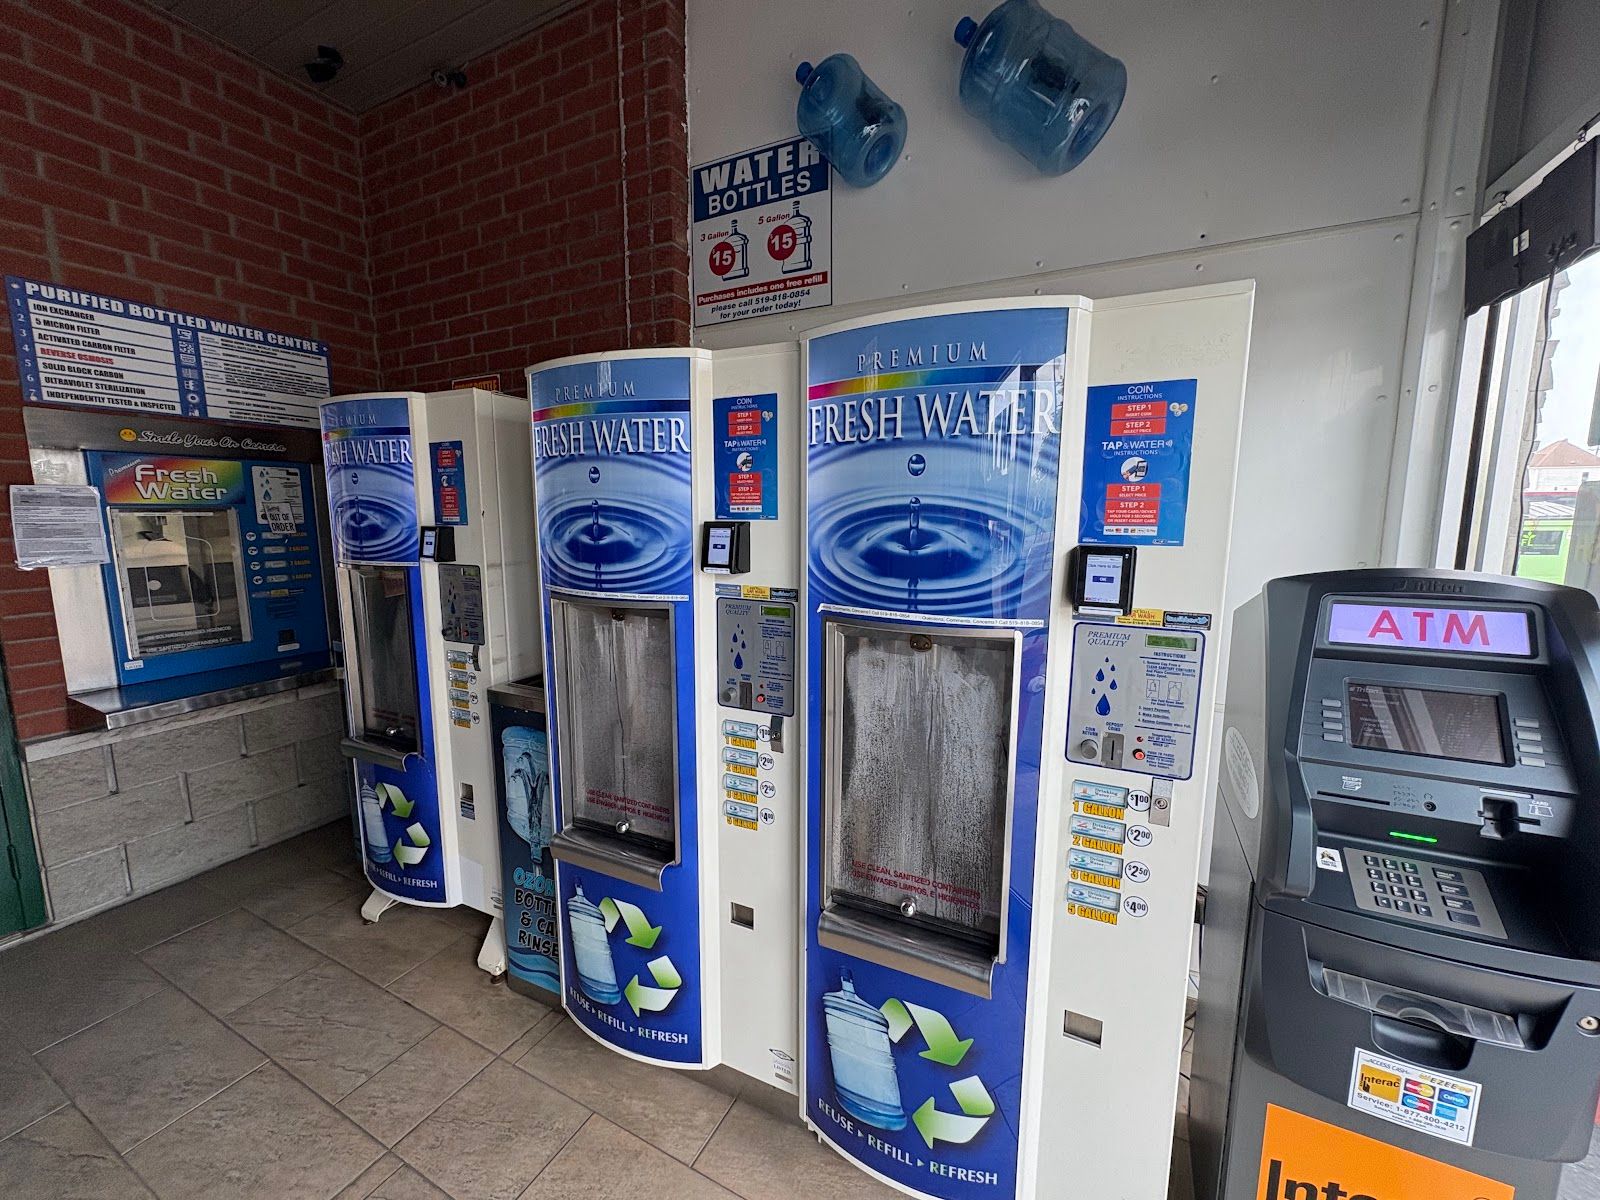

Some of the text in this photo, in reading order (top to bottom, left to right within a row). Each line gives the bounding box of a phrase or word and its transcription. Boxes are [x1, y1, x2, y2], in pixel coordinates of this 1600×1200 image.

[700, 140, 820, 194] WATER
[708, 171, 811, 215] BOTTLES
[758, 213, 790, 225] 5 Gallon
[707, 230, 729, 241] Gallon
[698, 275, 822, 304] Purchases includes one free refill
[15, 298, 95, 321] 1 ION EXCHANGER
[711, 303, 736, 314] please
[738, 298, 753, 308] call
[720, 299, 801, 319] for your order today!
[18, 314, 100, 336] 2 5 MICRON FILTER
[25, 281, 319, 353] PURIFIED BOTTLED WATER CENTRE
[20, 328, 136, 355] 3 ACTIVATED CARBON FILTER
[22, 343, 114, 365] 4 REVERSE OSMOSIS
[857, 341, 987, 371] PREMIUM
[24, 359, 124, 379] 5 SOLID BLOCK CARBON
[27, 374, 146, 395] 6 ULTRAVIOLET STERILIZATION
[555, 381, 636, 402] PREMIUM
[1127, 385, 1153, 395] COIN
[46, 390, 105, 403] INDEPENDENTLY
[107, 397, 133, 407] TESTED
[140, 401, 176, 411] INSPECTED
[1117, 393, 1163, 401] INSTRUCTIONS
[809, 389, 1060, 447] FRESH WATER
[138, 430, 287, 452] Smile Your On Camera
[534, 417, 691, 459] FRESH WATER
[351, 439, 413, 465] WATER
[134, 464, 218, 484] Fresh
[134, 481, 228, 501] Water
[271, 522, 295, 532] ORDER
[724, 603, 751, 611] PREMIUM
[1087, 630, 1131, 641] PREMIUM
[1368, 609, 1490, 646] ATM
[1087, 638, 1127, 648] QUALITY
[1153, 651, 1187, 660] INSTRUCTIONS
[730, 737, 757, 750] GALLON
[731, 764, 758, 777] GALLON
[732, 791, 758, 804] GALLON
[1072, 800, 1125, 820] 1 GALLON
[732, 817, 758, 831] GALLON
[1072, 834, 1123, 855] 2 GALLON
[403, 876, 438, 889] REFRESH
[852, 860, 865, 870] USE
[893, 870, 930, 886] SANITIZED
[931, 880, 981, 900] CONTAINERS
[1071, 868, 1121, 889] 3 GALLON
[852, 871, 864, 879] USE
[866, 874, 898, 889] ENVASES
[938, 893, 980, 911] HIGIENICOS
[515, 888, 557, 917] BOTTL
[520, 911, 532, 928] &
[1067, 902, 1118, 925] 5 GALLON
[518, 929, 559, 957] RINSE
[598, 1010, 627, 1032] REFILL
[638, 1026, 689, 1044] REFRESH
[1368, 1058, 1391, 1070] ACCESS
[1361, 1073, 1400, 1088] Interac
[1430, 1077, 1457, 1090] EZEE
[818, 1097, 854, 1134] REUSE
[1357, 1092, 1393, 1110] Service:
[1396, 1106, 1465, 1132] 1-877-400-4212
[867, 1133, 913, 1166] REFILL
[930, 1160, 998, 1185] REFRESH
